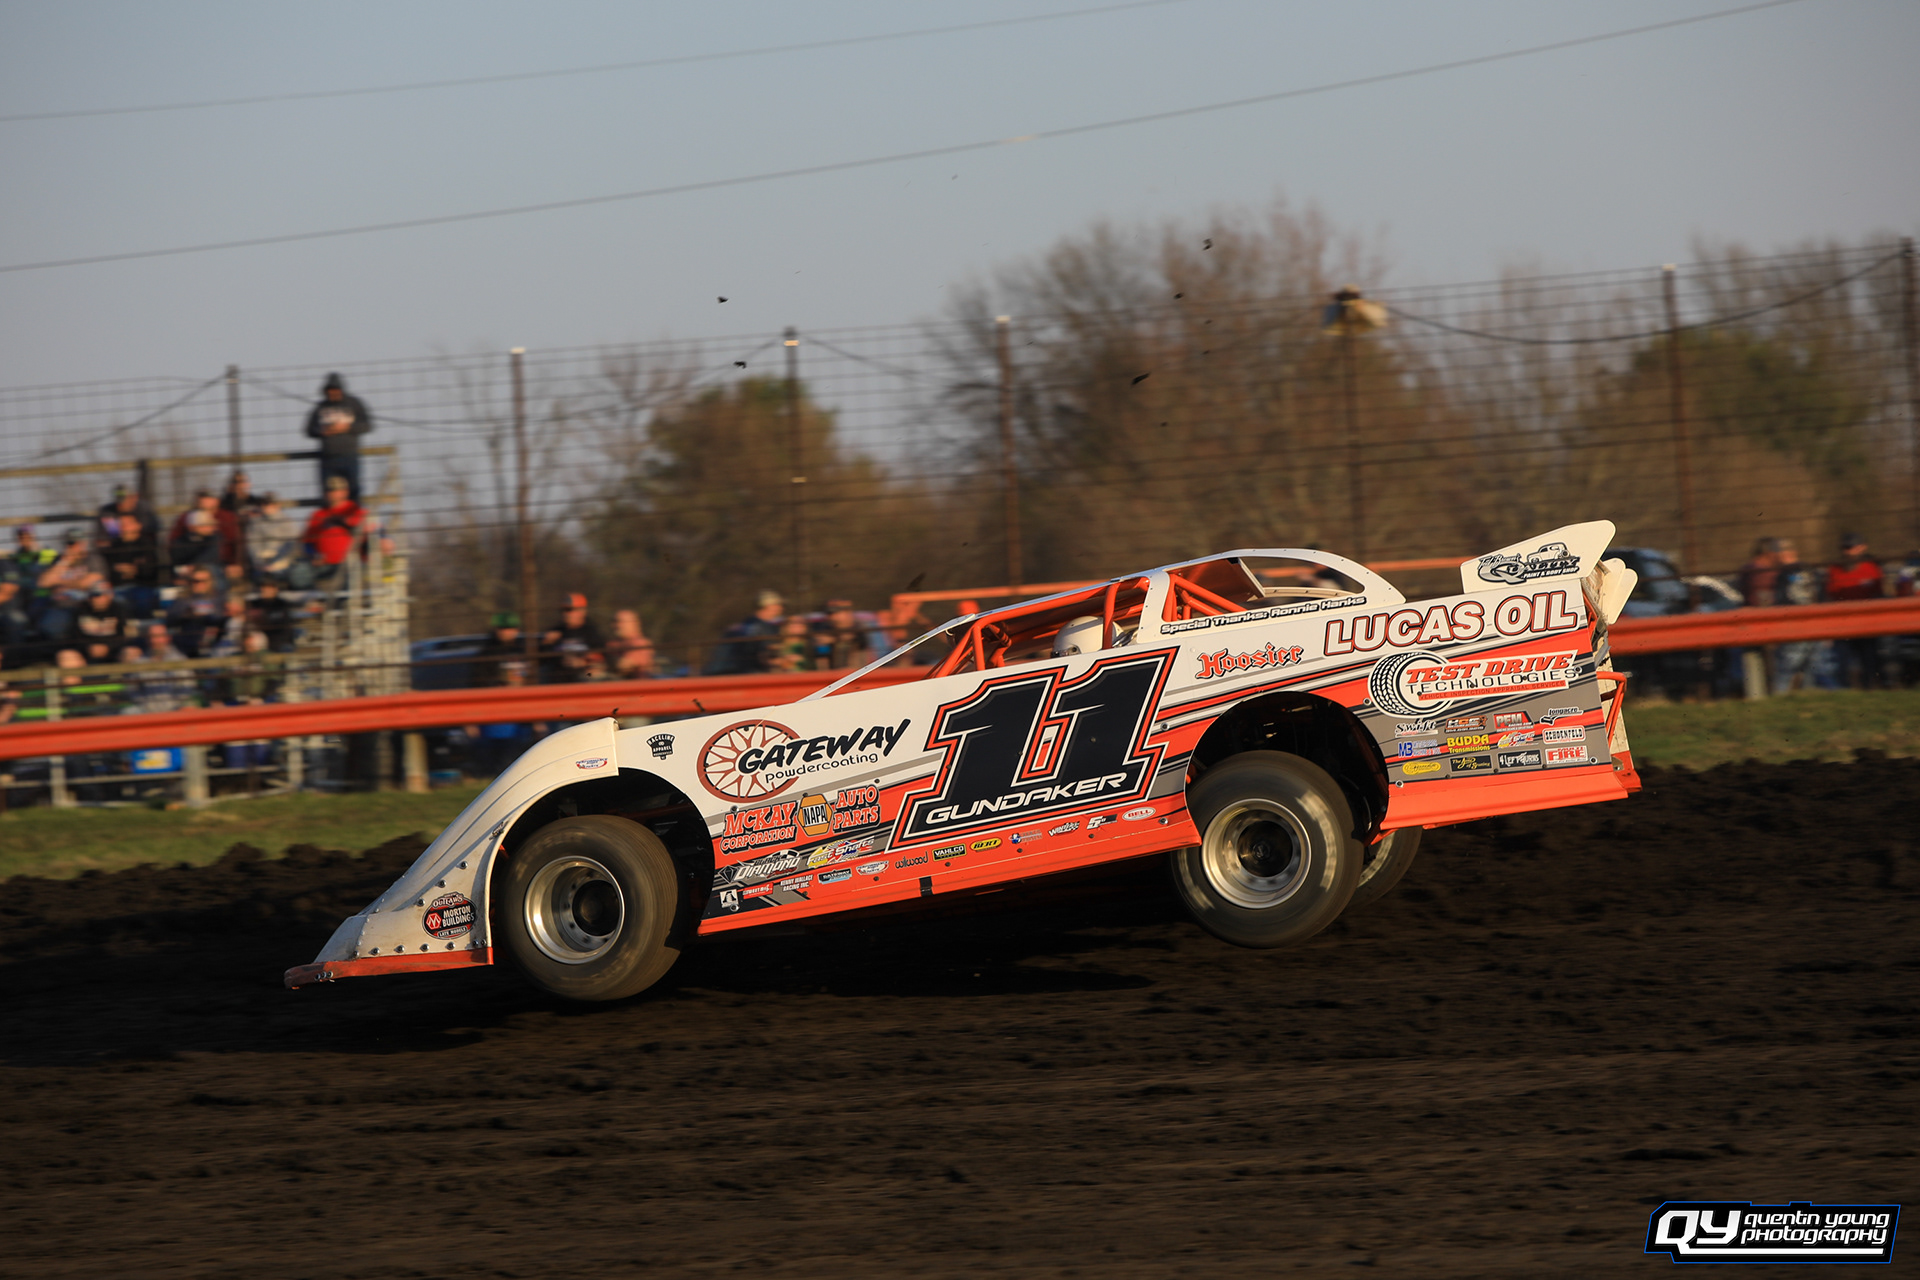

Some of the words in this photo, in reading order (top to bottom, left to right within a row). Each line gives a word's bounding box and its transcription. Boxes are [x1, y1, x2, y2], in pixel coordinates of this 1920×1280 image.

[1523, 571, 1540, 579] PAINT
[1161, 618, 1209, 635] Special
[1213, 611, 1268, 627] Thanks:
[1271, 604, 1319, 618] Ronnie
[1321, 596, 1367, 612] Hanks
[1323, 600, 1485, 656] LUCAS
[1494, 590, 1578, 637] OIL
[1195, 642, 1304, 679] Hoosier
[1405, 662, 1480, 684] TEST
[1484, 653, 1574, 676] DRIVE
[1405, 667, 1577, 694] TECHNOLOGIES
[1420, 692, 1450, 700] VEHICLE
[1450, 688, 1491, 698] INSPECTION
[1492, 684, 1530, 694] APPRAISAL
[1531, 681, 1566, 691] SERVICES
[1396, 718, 1437, 733] Swift
[1545, 728, 1582, 741] SCHOENFELD
[647, 734, 675, 745] RACELINE
[738, 718, 912, 774] GATEWAY
[908, 647, 1179, 838] 11
[1447, 734, 1489, 747] BUDDA
[1448, 745, 1490, 753] Transmissions
[1548, 748, 1586, 761] FIRE
[765, 753, 879, 783] powdercoating
[837, 786, 878, 808] AUTO
[926, 772, 1128, 825] GUNDAKER
[803, 803, 827, 826] NAPA
[834, 806, 879, 829] PARTS
[1128, 809, 1152, 817] BELL
[721, 826, 796, 850] CORPORATION
[895, 851, 929, 869] wilwood
[934, 845, 965, 857] VAHLCO
[734, 857, 800, 880] DIAMOND
[783, 883, 800, 891] RACING
[433, 894, 463, 908] OUTLAWS
[442, 912, 475, 927] BUILDINGS
[443, 905, 471, 918] MORTON
